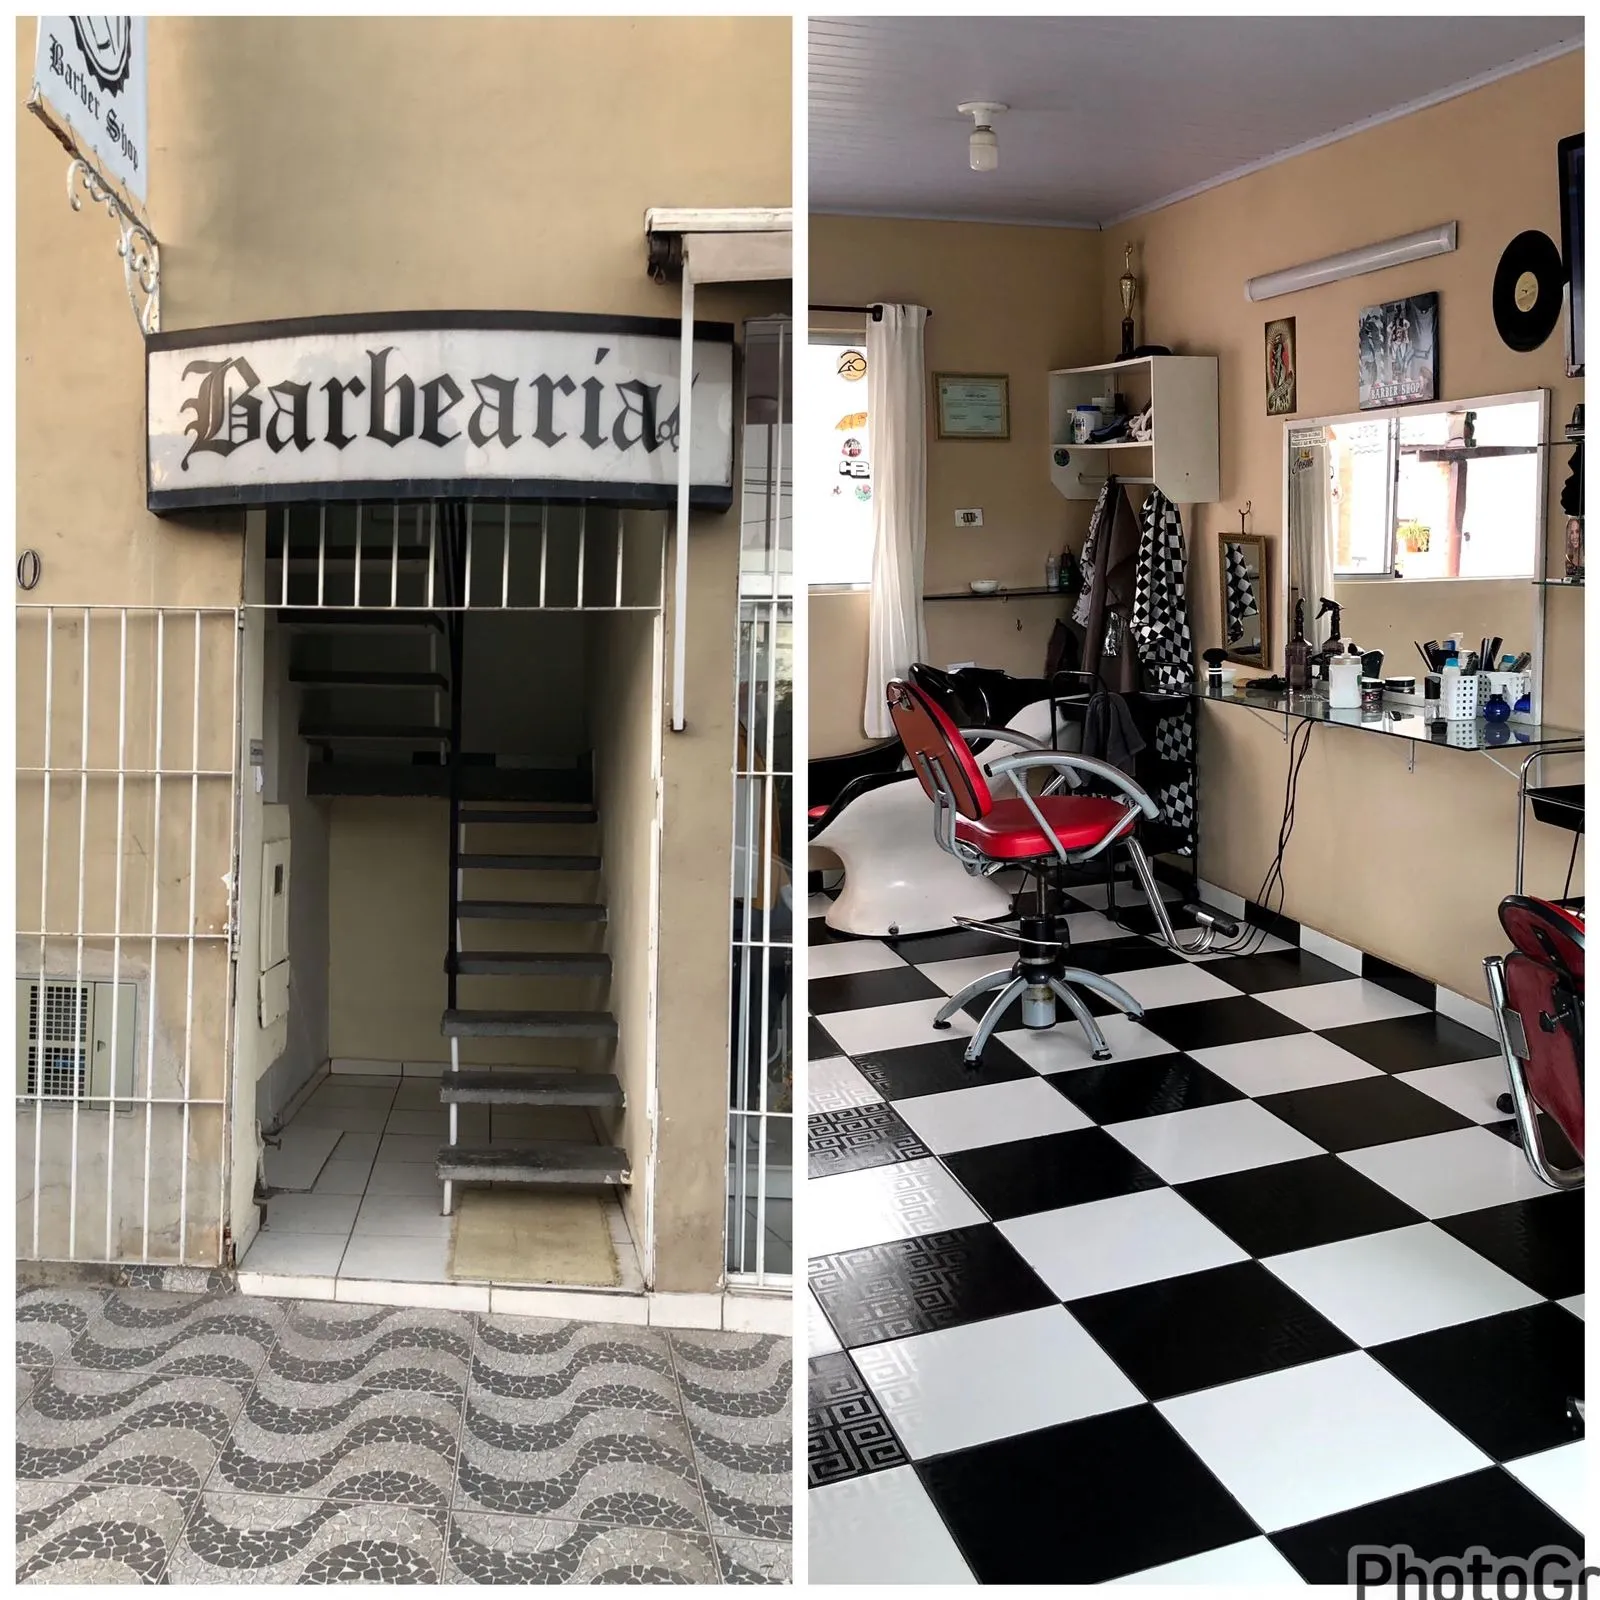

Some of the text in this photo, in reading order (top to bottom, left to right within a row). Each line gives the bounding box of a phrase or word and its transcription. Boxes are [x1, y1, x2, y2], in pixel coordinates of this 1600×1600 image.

[49, 33, 138, 172] Barber Shop
[1371, 382, 1420, 400] BARBER SHOP
